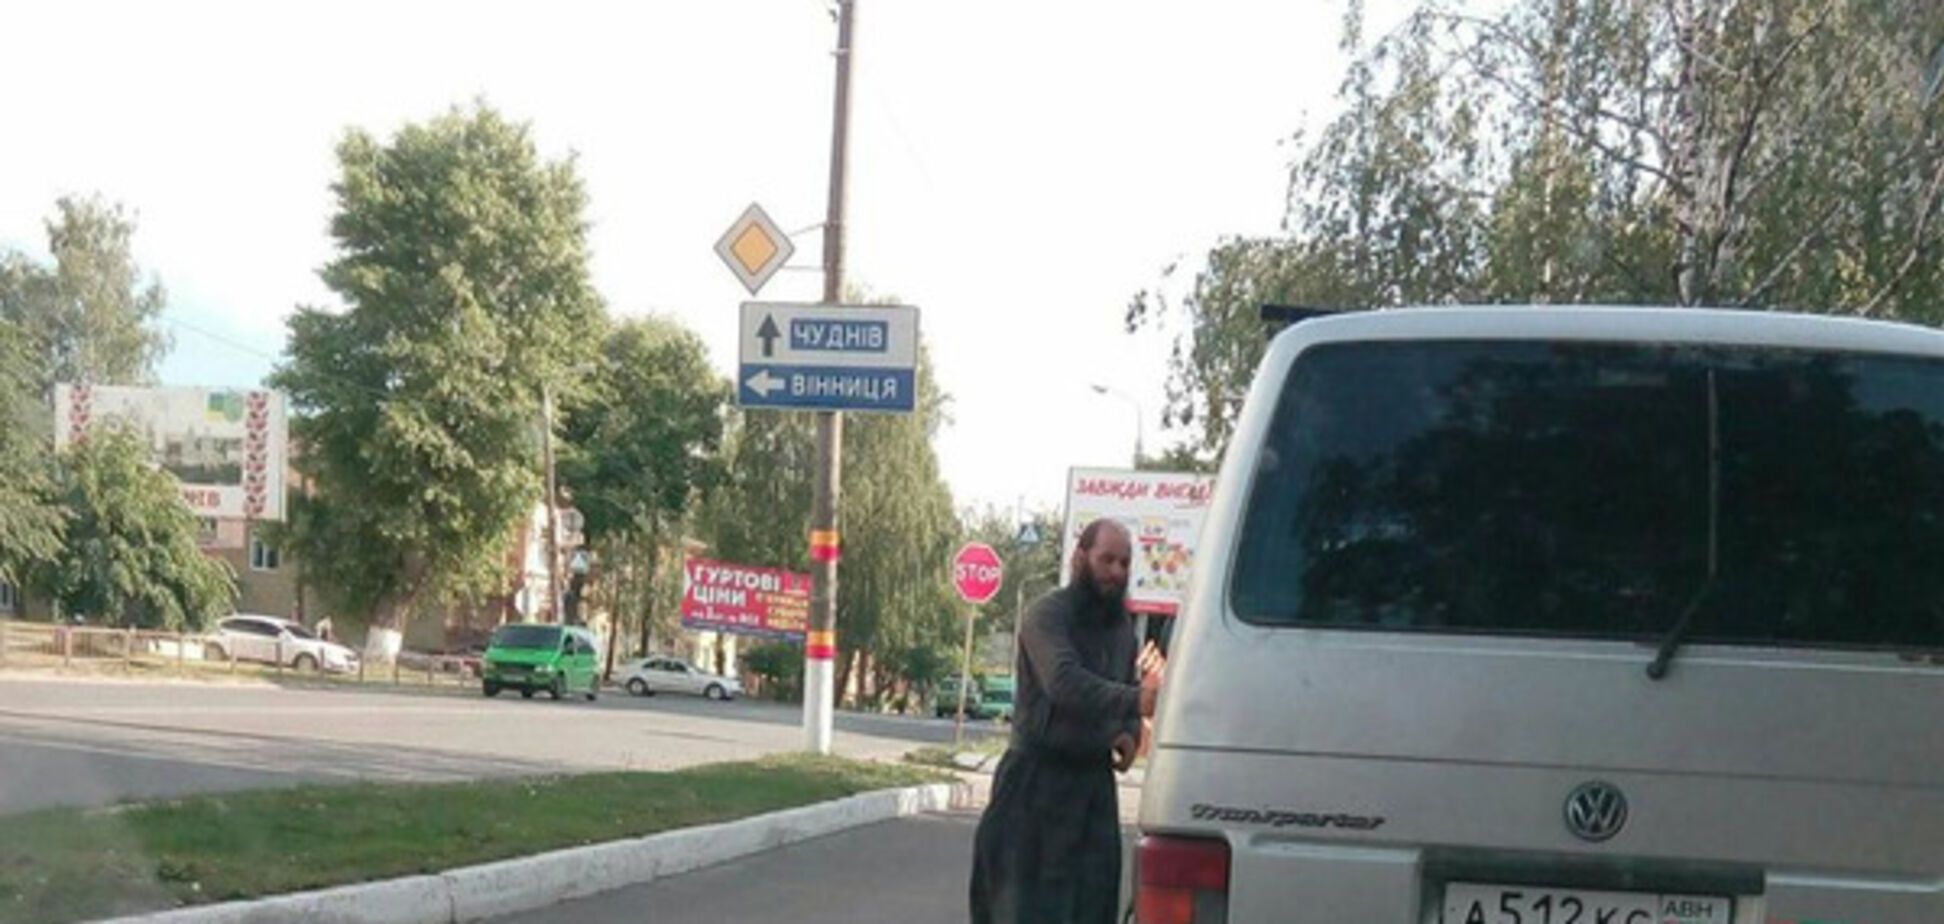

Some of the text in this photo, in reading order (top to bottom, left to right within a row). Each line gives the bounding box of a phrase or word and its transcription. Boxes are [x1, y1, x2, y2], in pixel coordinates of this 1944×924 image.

[794, 322, 883, 348] ЧУДНІВ
[792, 375, 897, 401] ВІННИЦЯ
[694, 565, 780, 592] ГУРТОВІ
[956, 563, 1002, 582] STOP
[693, 585, 746, 607] ЦІНИ
